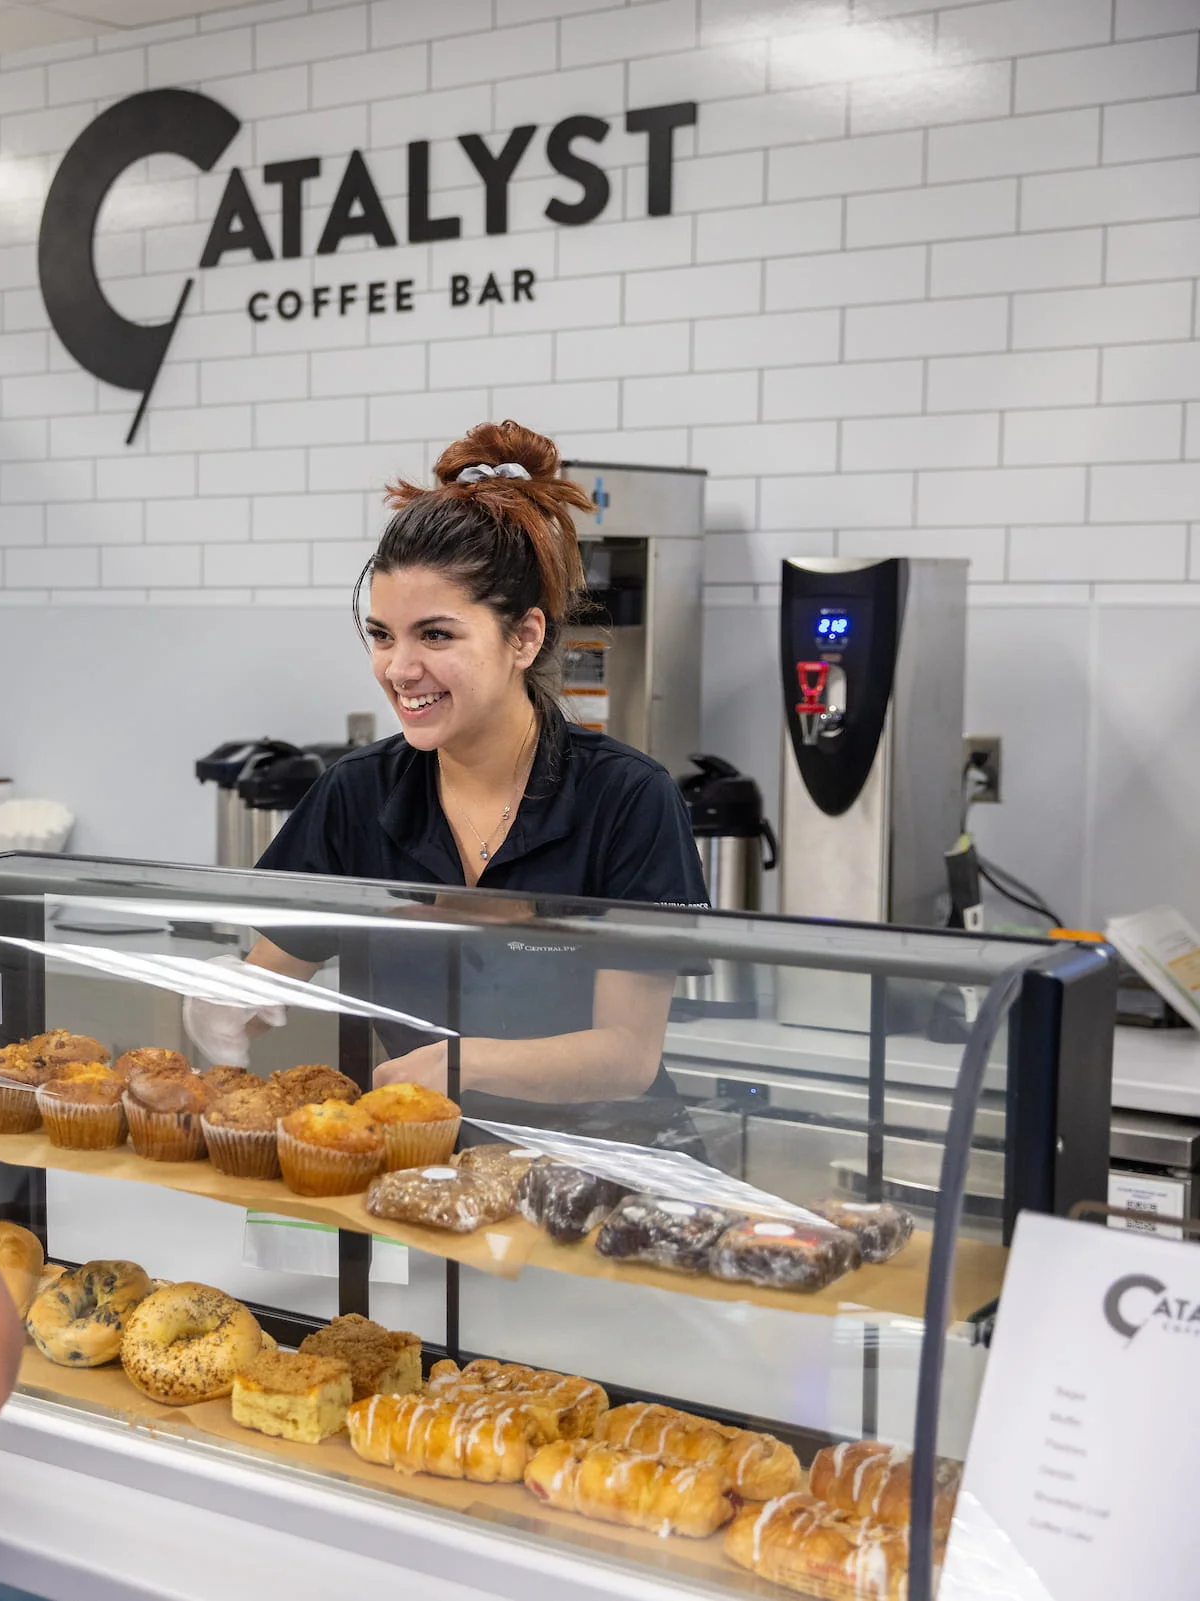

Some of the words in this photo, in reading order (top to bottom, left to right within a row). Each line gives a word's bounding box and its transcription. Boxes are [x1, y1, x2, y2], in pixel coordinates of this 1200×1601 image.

[38, 87, 698, 445] CATALYST
[247, 279, 415, 322] COFFEE
[450, 269, 536, 307] BAR
